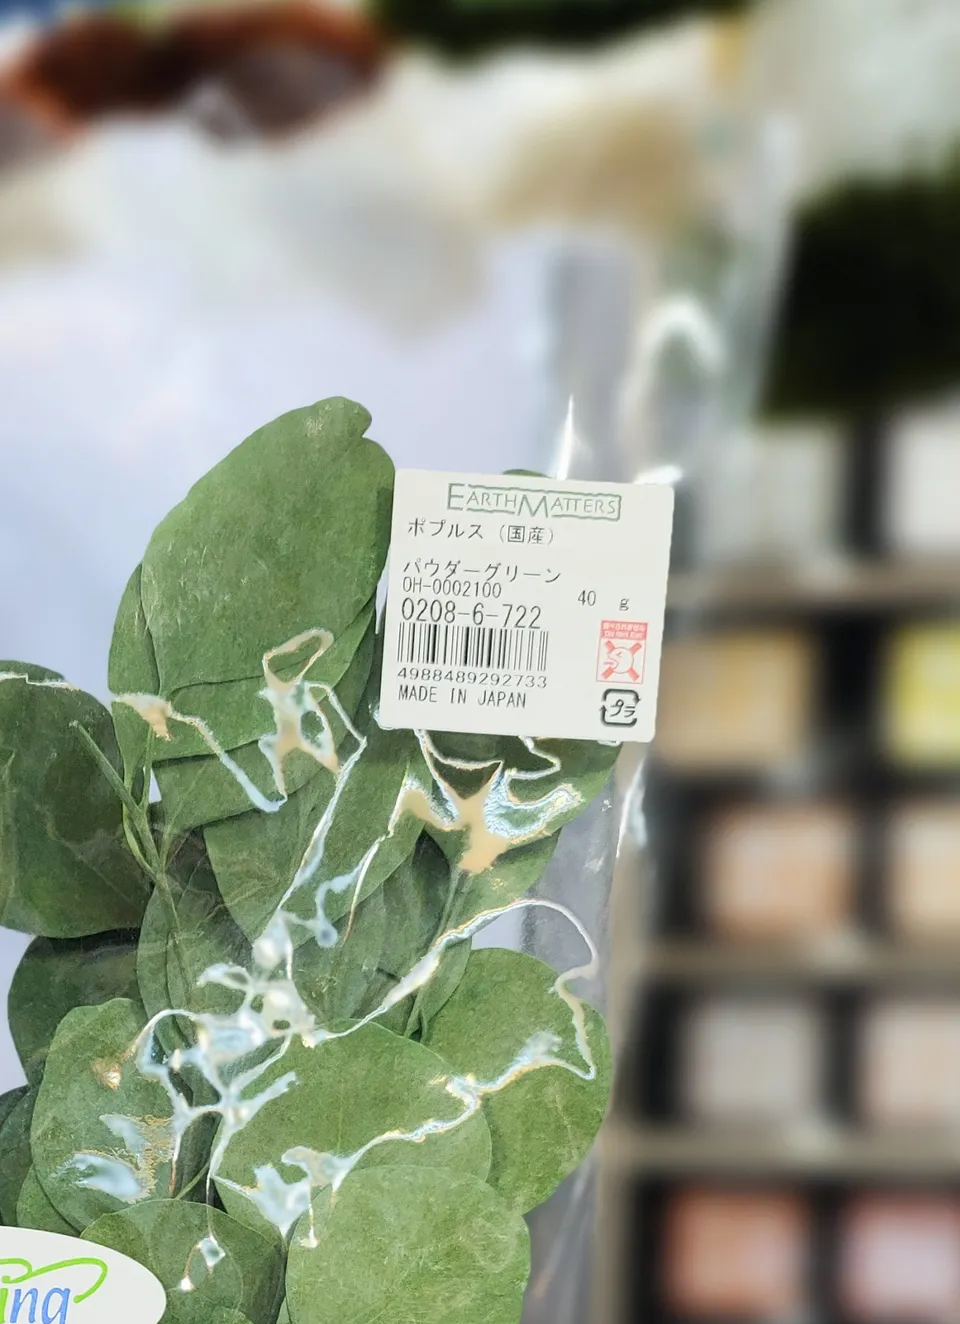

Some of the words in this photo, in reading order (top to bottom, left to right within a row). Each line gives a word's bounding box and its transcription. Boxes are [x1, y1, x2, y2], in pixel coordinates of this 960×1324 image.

[403, 558, 561, 583] パウダーグリーン
[402, 576, 502, 598] OH-0002100
[577, 590, 597, 606] 40
[619, 598, 630, 611] g
[401, 597, 542, 629] 0208-6-722
[397, 667, 548, 689] 4988489292733
[398, 684, 439, 702] MADE
[450, 687, 467, 704] IN
[477, 690, 527, 708] JAPAN
[610, 698, 636, 718] プラ
